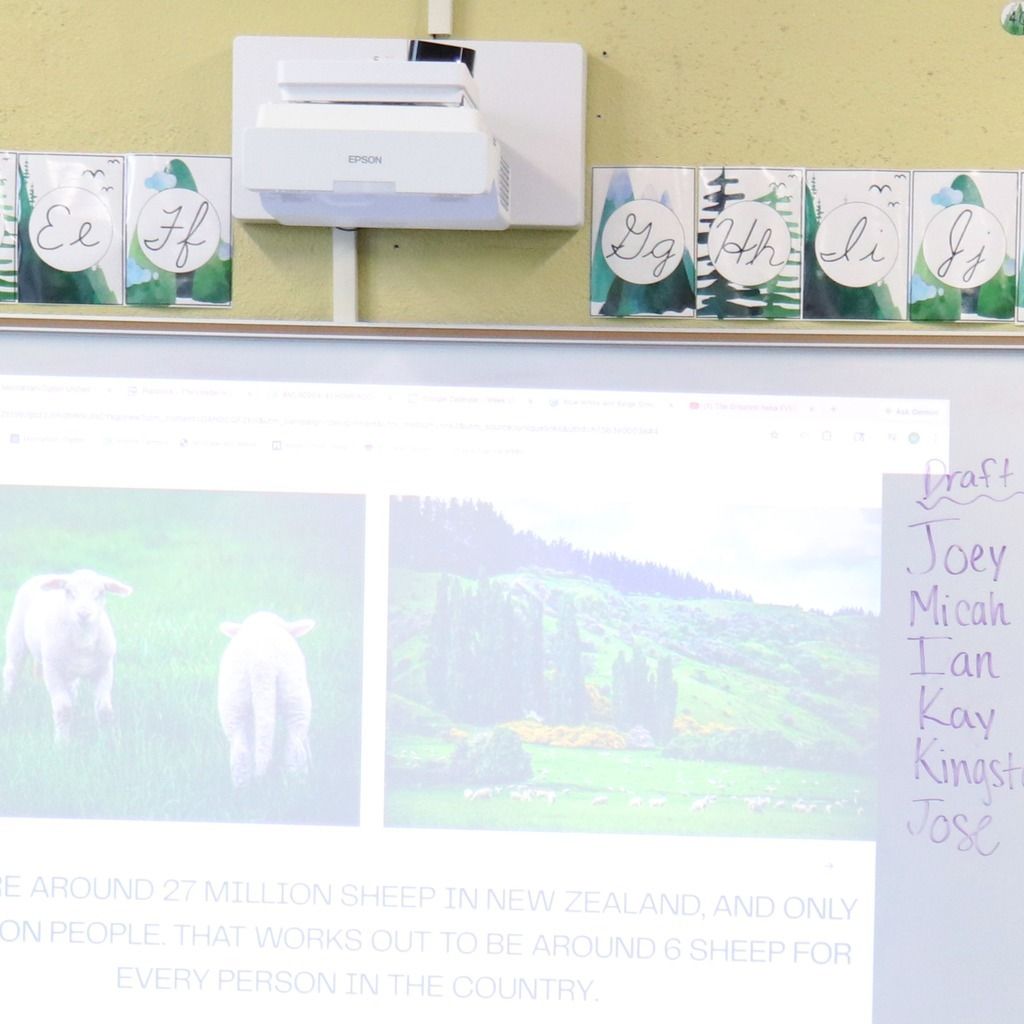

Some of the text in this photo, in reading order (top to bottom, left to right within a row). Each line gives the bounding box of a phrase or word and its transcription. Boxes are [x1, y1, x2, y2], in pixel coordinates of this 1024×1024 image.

[348, 155, 382, 165] EPSON
[37, 203, 100, 249] Ee
[145, 199, 210, 267] Ff
[605, 214, 683, 274] Gg
[715, 218, 784, 269] Hh
[820, 215, 886, 264] Ii
[946, 208, 988, 281] Jj
[923, 458, 1014, 501] Draft
[906, 518, 1007, 582] Joey
[910, 585, 1012, 627] Micah
[907, 636, 1000, 679] Ian
[919, 685, 996, 741] Kay
[31, 876, 154, 901] AROUND
[163, 879, 196, 902] 27
[205, 880, 332, 905] MILLION
[340, 884, 436, 909] SHEEP
[445, 887, 478, 910] IN
[487, 888, 555, 912] NEW
[565, 890, 706, 920] ZEALAND,
[713, 895, 775, 918] AND
[784, 896, 858, 920] ONLY
[0, 919, 852, 965] ON PEOPLE. THAT WORKS OUT TO BE AROUND 6 SHEEP FOR
[117, 966, 600, 1002] EVERY PERSON IN THE COUNTRY.
